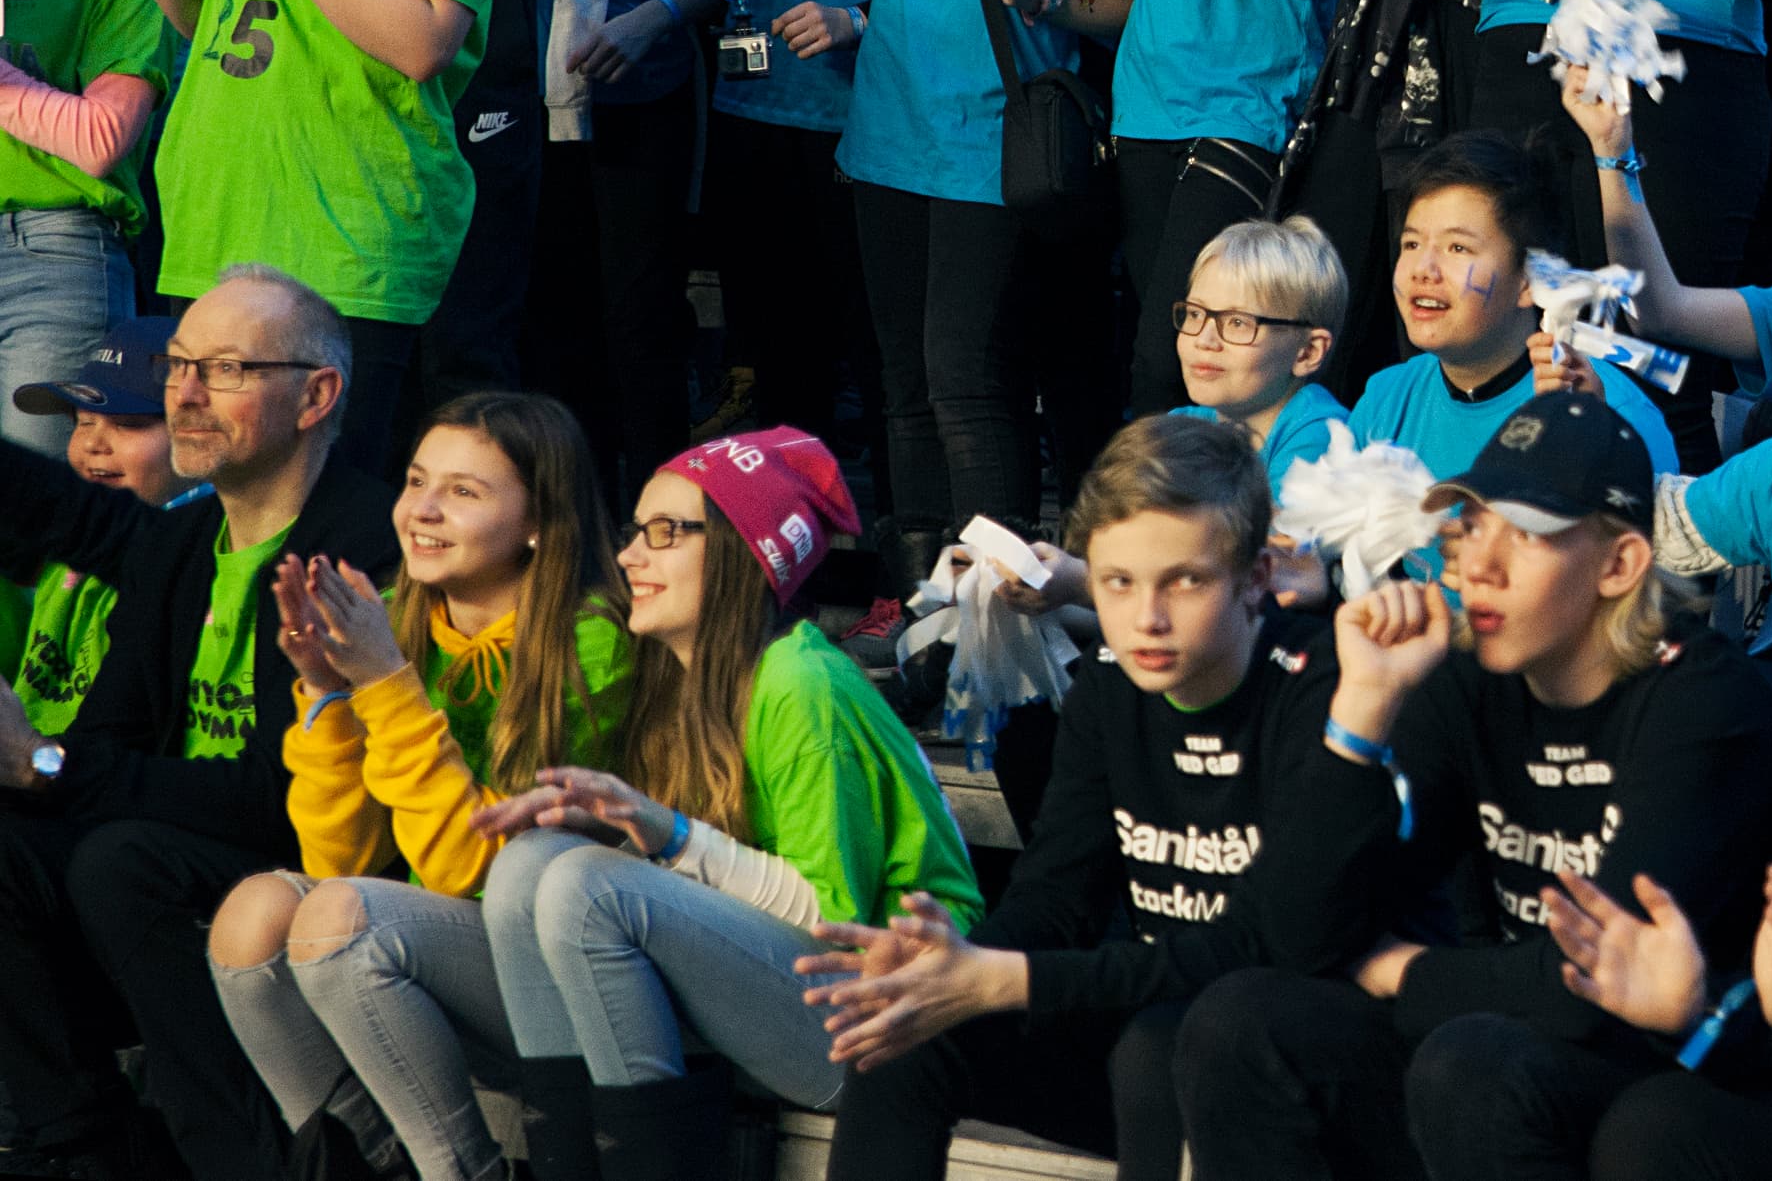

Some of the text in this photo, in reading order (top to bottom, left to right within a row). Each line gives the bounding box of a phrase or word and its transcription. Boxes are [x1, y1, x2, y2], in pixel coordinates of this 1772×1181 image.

[476, 111, 509, 130] NIKE
[1543, 745, 1587, 761] TEAM
[1113, 806, 1262, 875] Sanistål
